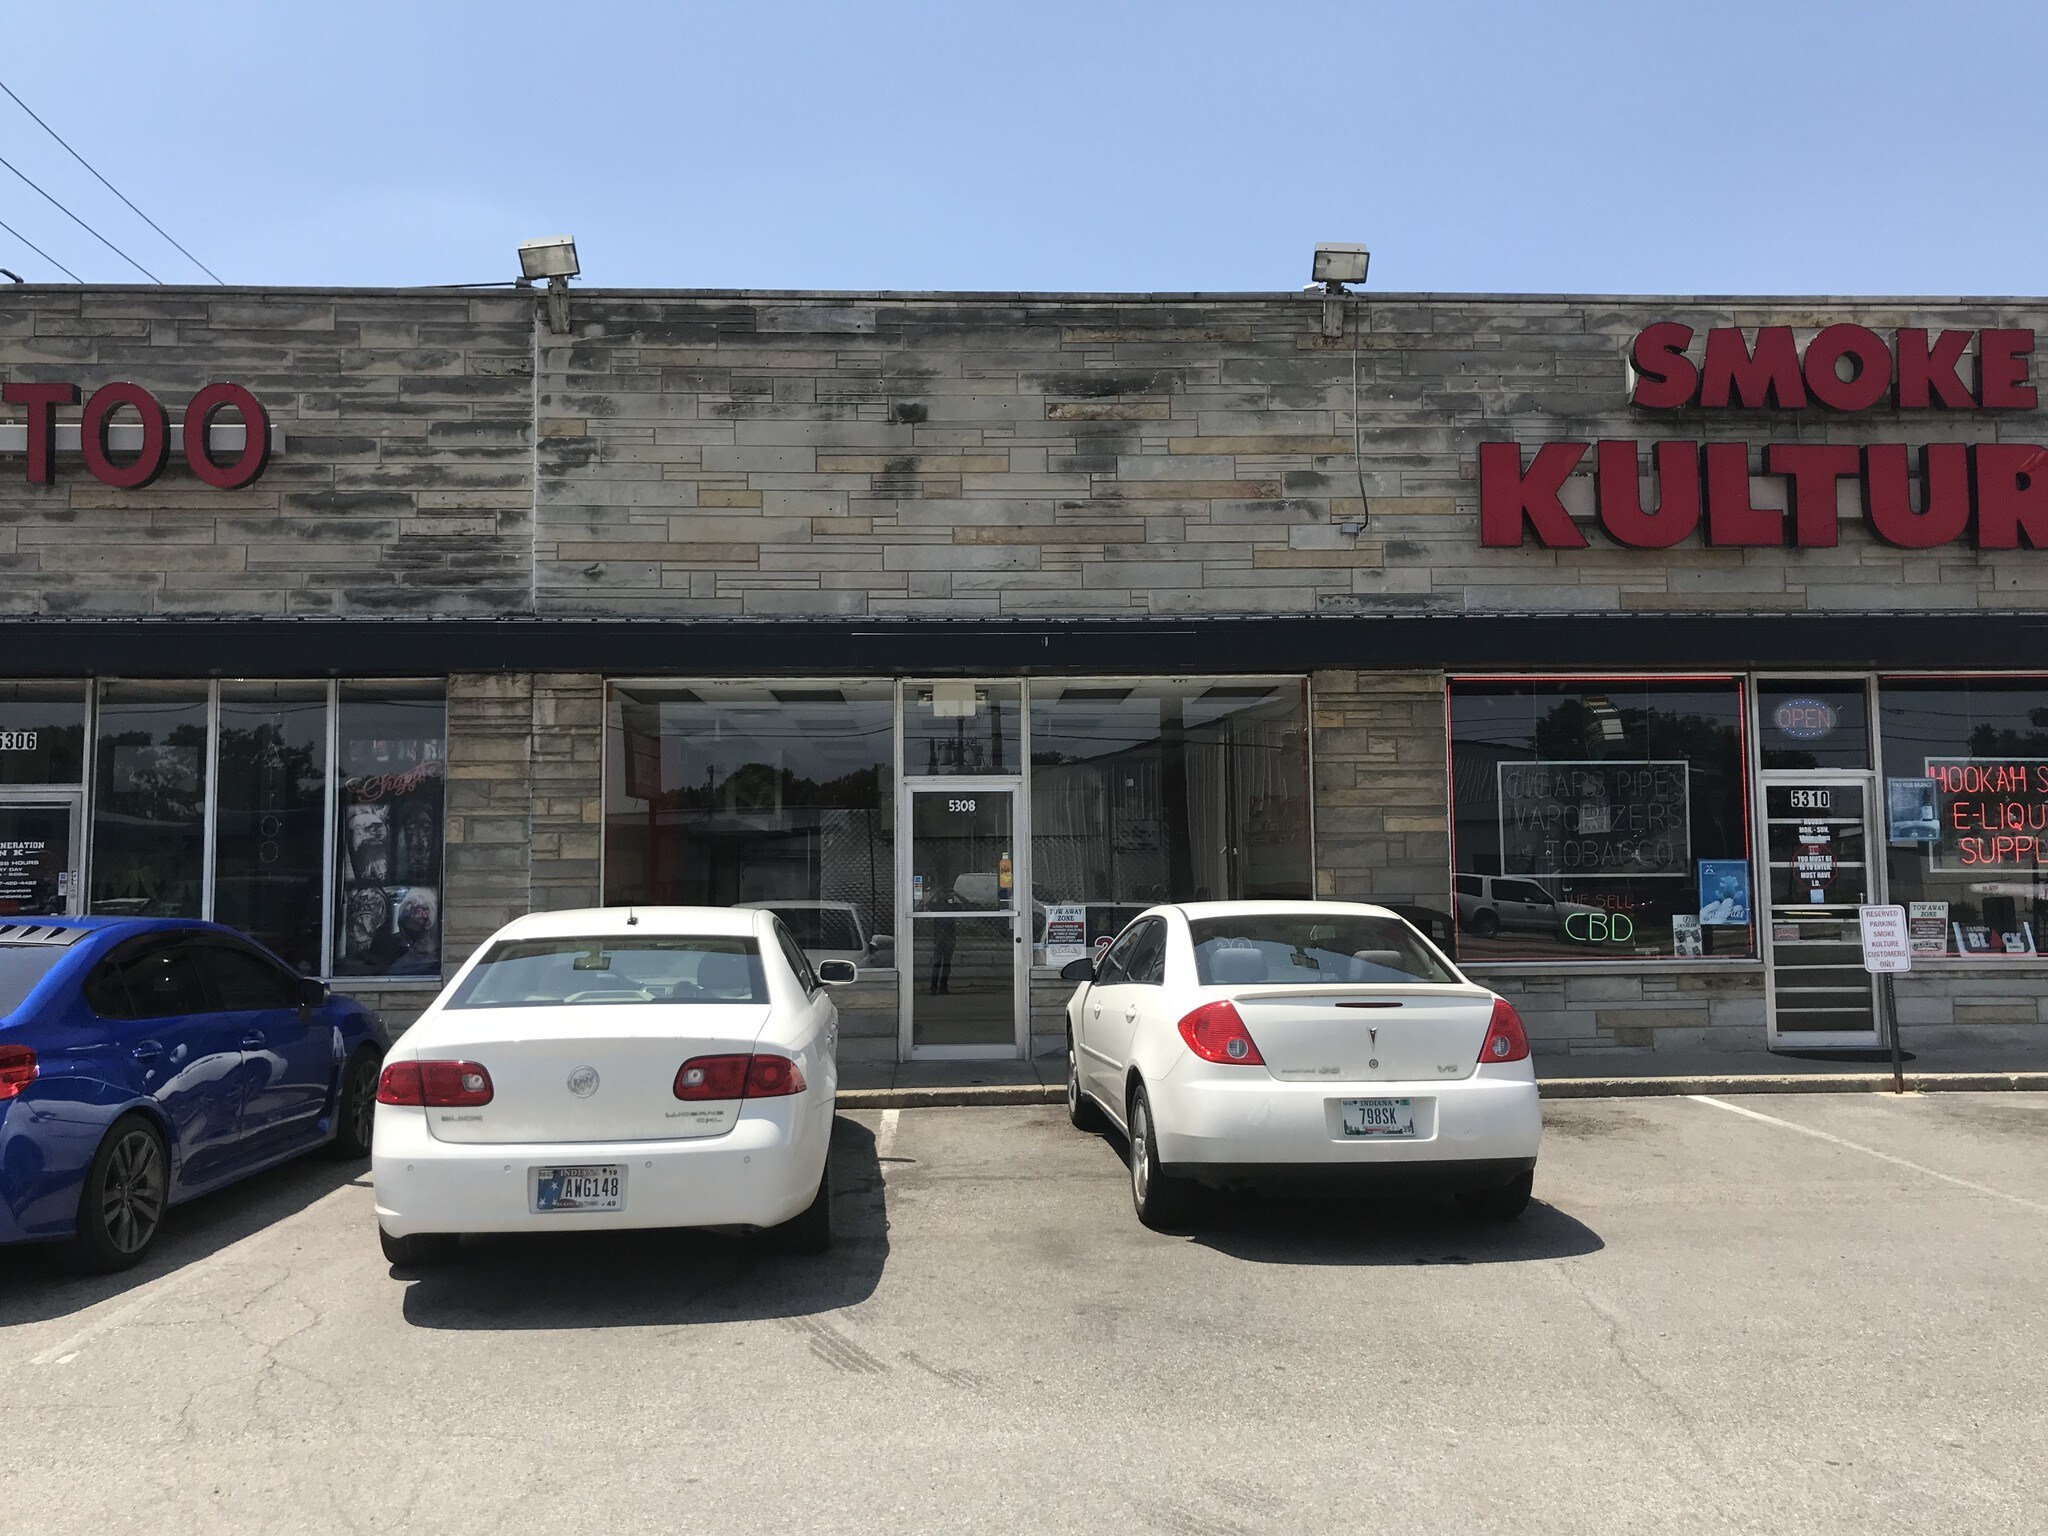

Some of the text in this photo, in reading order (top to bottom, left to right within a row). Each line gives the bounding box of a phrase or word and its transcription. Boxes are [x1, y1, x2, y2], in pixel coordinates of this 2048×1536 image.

[1630, 320, 2039, 413] SMOKE
[2, 381, 272, 490] TOO
[1476, 440, 2048, 550] KULTUR
[1778, 708, 1832, 729] OPEN
[1506, 769, 1687, 799] CIGARS PIPES
[1929, 766, 2028, 794] HOOKAH
[948, 799, 977, 812] 5308
[1792, 791, 1829, 807] 5310
[1514, 803, 1683, 832] VAPORIZERS
[1543, 840, 1674, 868] TOBACCO
[1564, 893, 1635, 909] WE SELL
[1865, 910, 1899, 918] RESERVED
[1564, 912, 1634, 942] CBD
[1869, 920, 1898, 928] PARKING
[1872, 930, 1896, 938] SMOKE
[1871, 940, 1900, 948] KULTURE
[1867, 950, 1906, 958] CUSTOMERS
[1879, 959, 1896, 968] ONLY
[1358, 1107, 1398, 1125] 798SK
[565, 1177, 619, 1198] AWG148
